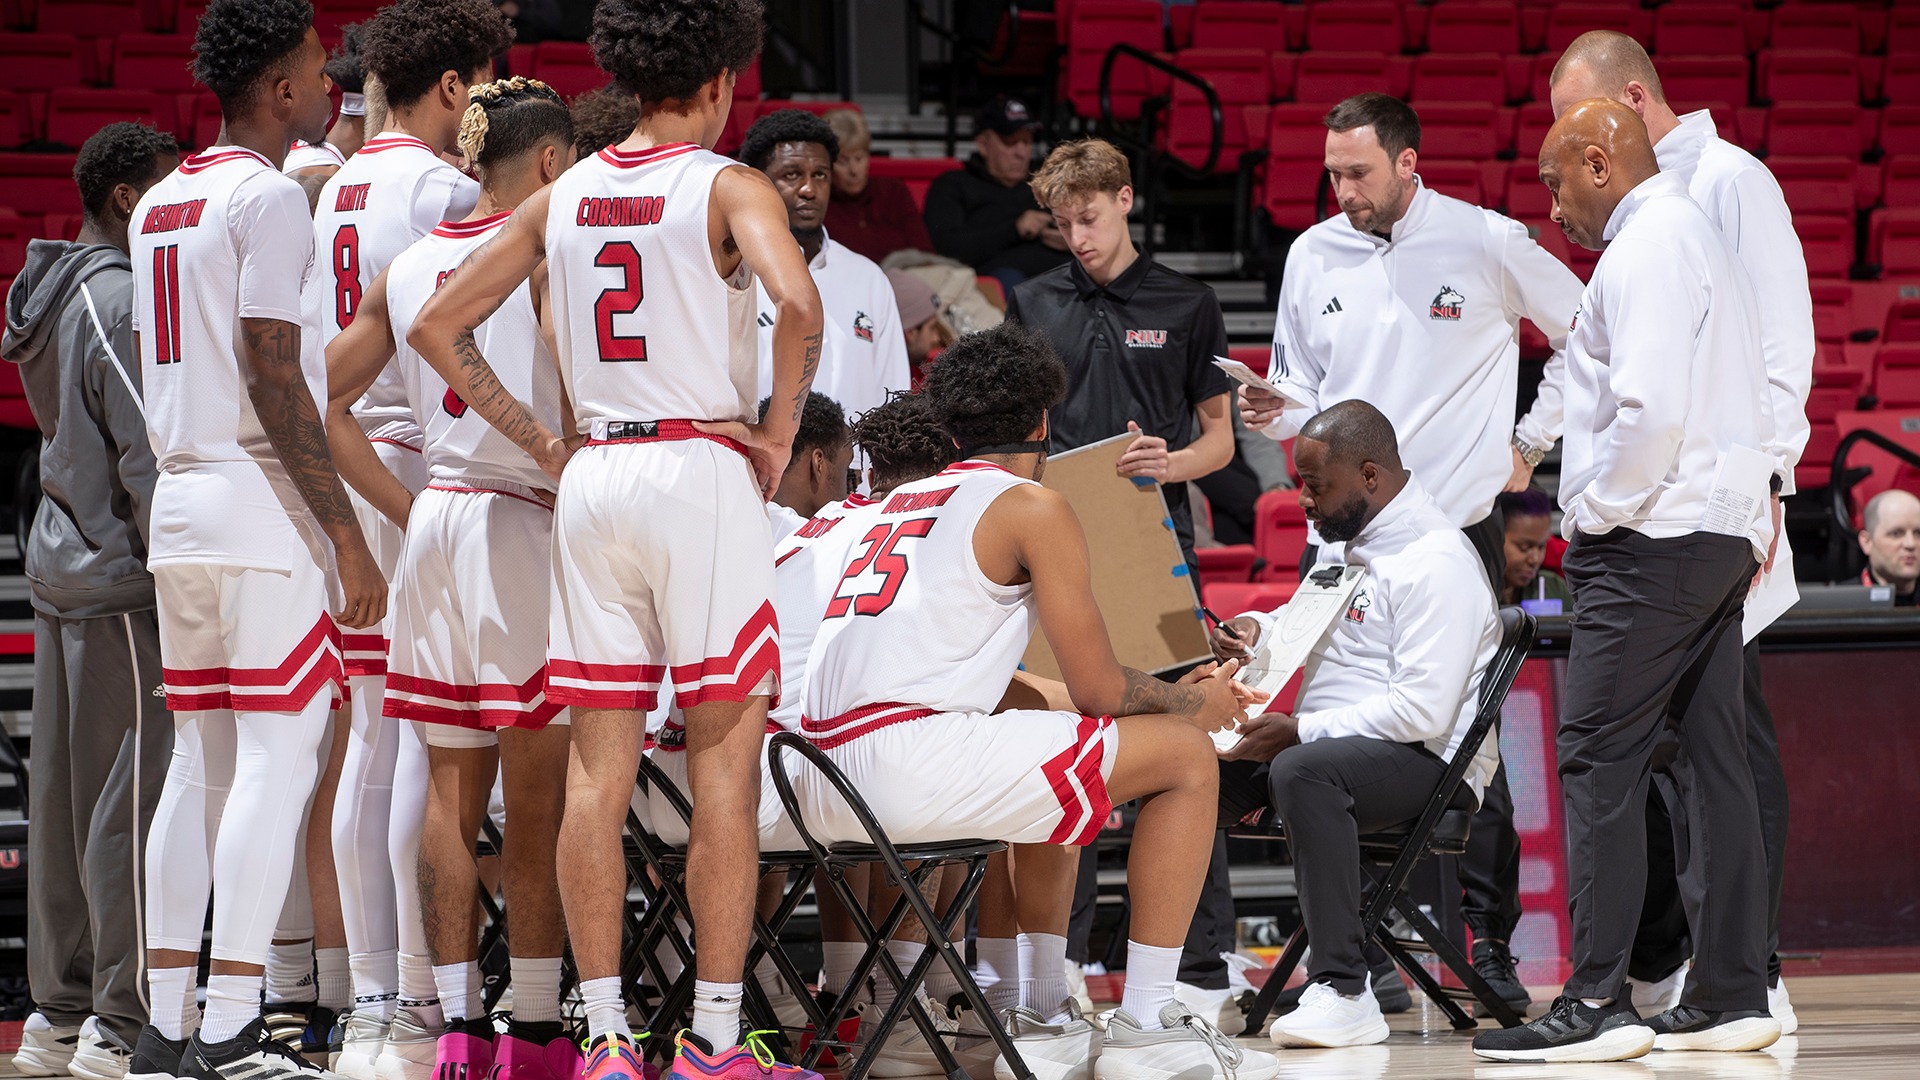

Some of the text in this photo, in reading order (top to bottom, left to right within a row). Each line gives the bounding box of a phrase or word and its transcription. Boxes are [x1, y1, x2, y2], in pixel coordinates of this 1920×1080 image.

[576, 196, 665, 227] CORONADO
[153, 243, 181, 365] 11
[333, 223, 362, 331] 8
[594, 240, 648, 362] 2
[1429, 305, 1462, 319] NIU
[1125, 329, 1168, 345] NIU
[822, 516, 938, 622] 25
